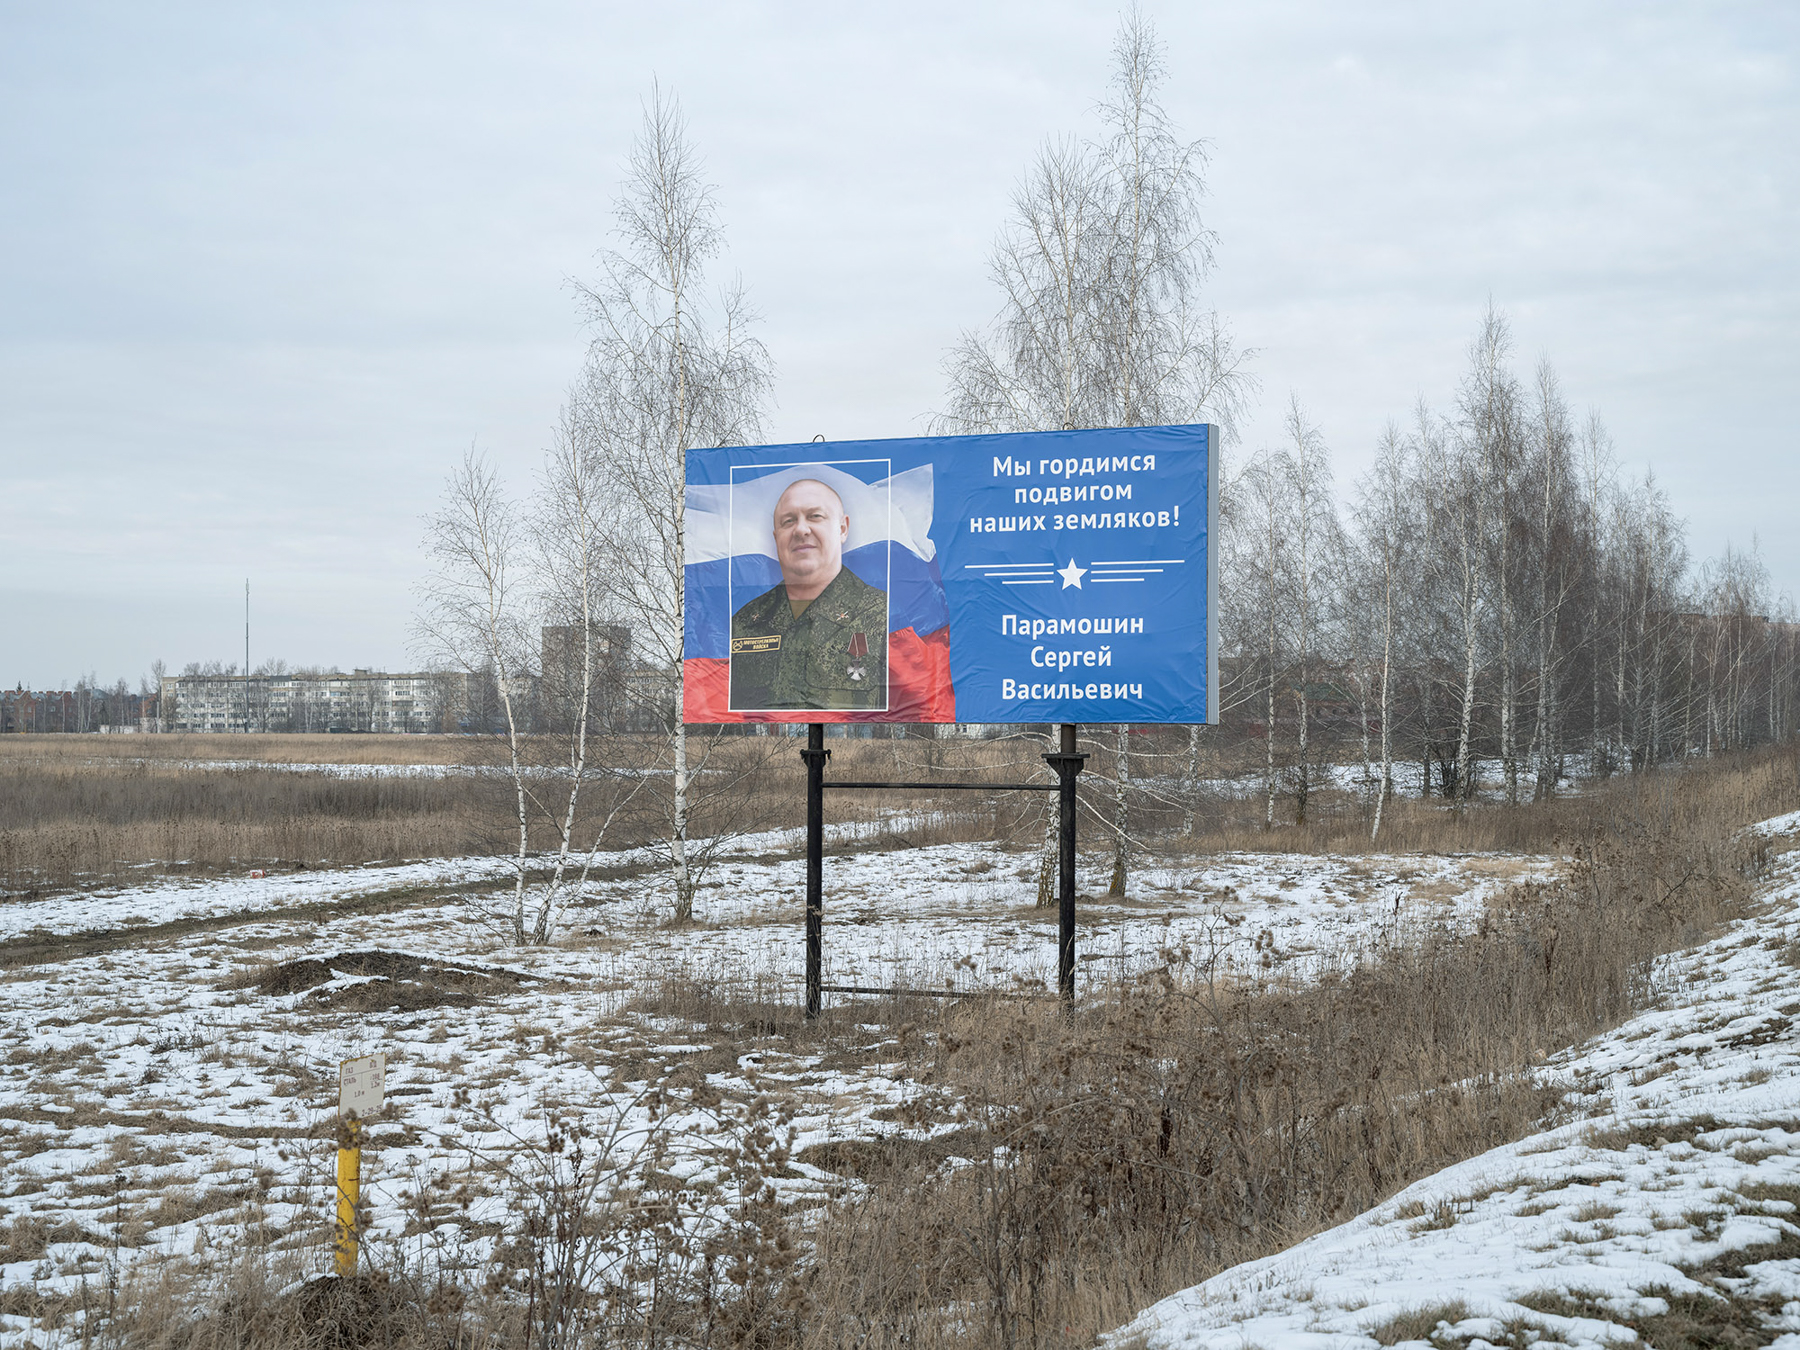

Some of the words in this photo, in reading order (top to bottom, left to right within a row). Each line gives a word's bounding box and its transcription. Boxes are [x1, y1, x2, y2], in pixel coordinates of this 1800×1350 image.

[993, 456, 1031, 477] Мы
[1039, 455, 1156, 480] гордимся
[1014, 484, 1132, 506] подвигом
[970, 515, 1046, 533] наших
[1053, 505, 1180, 531] земляков!
[1002, 614, 1144, 641] Парамошин
[1030, 645, 1112, 673] Сергей
[1002, 678, 1143, 700] Васильевич
